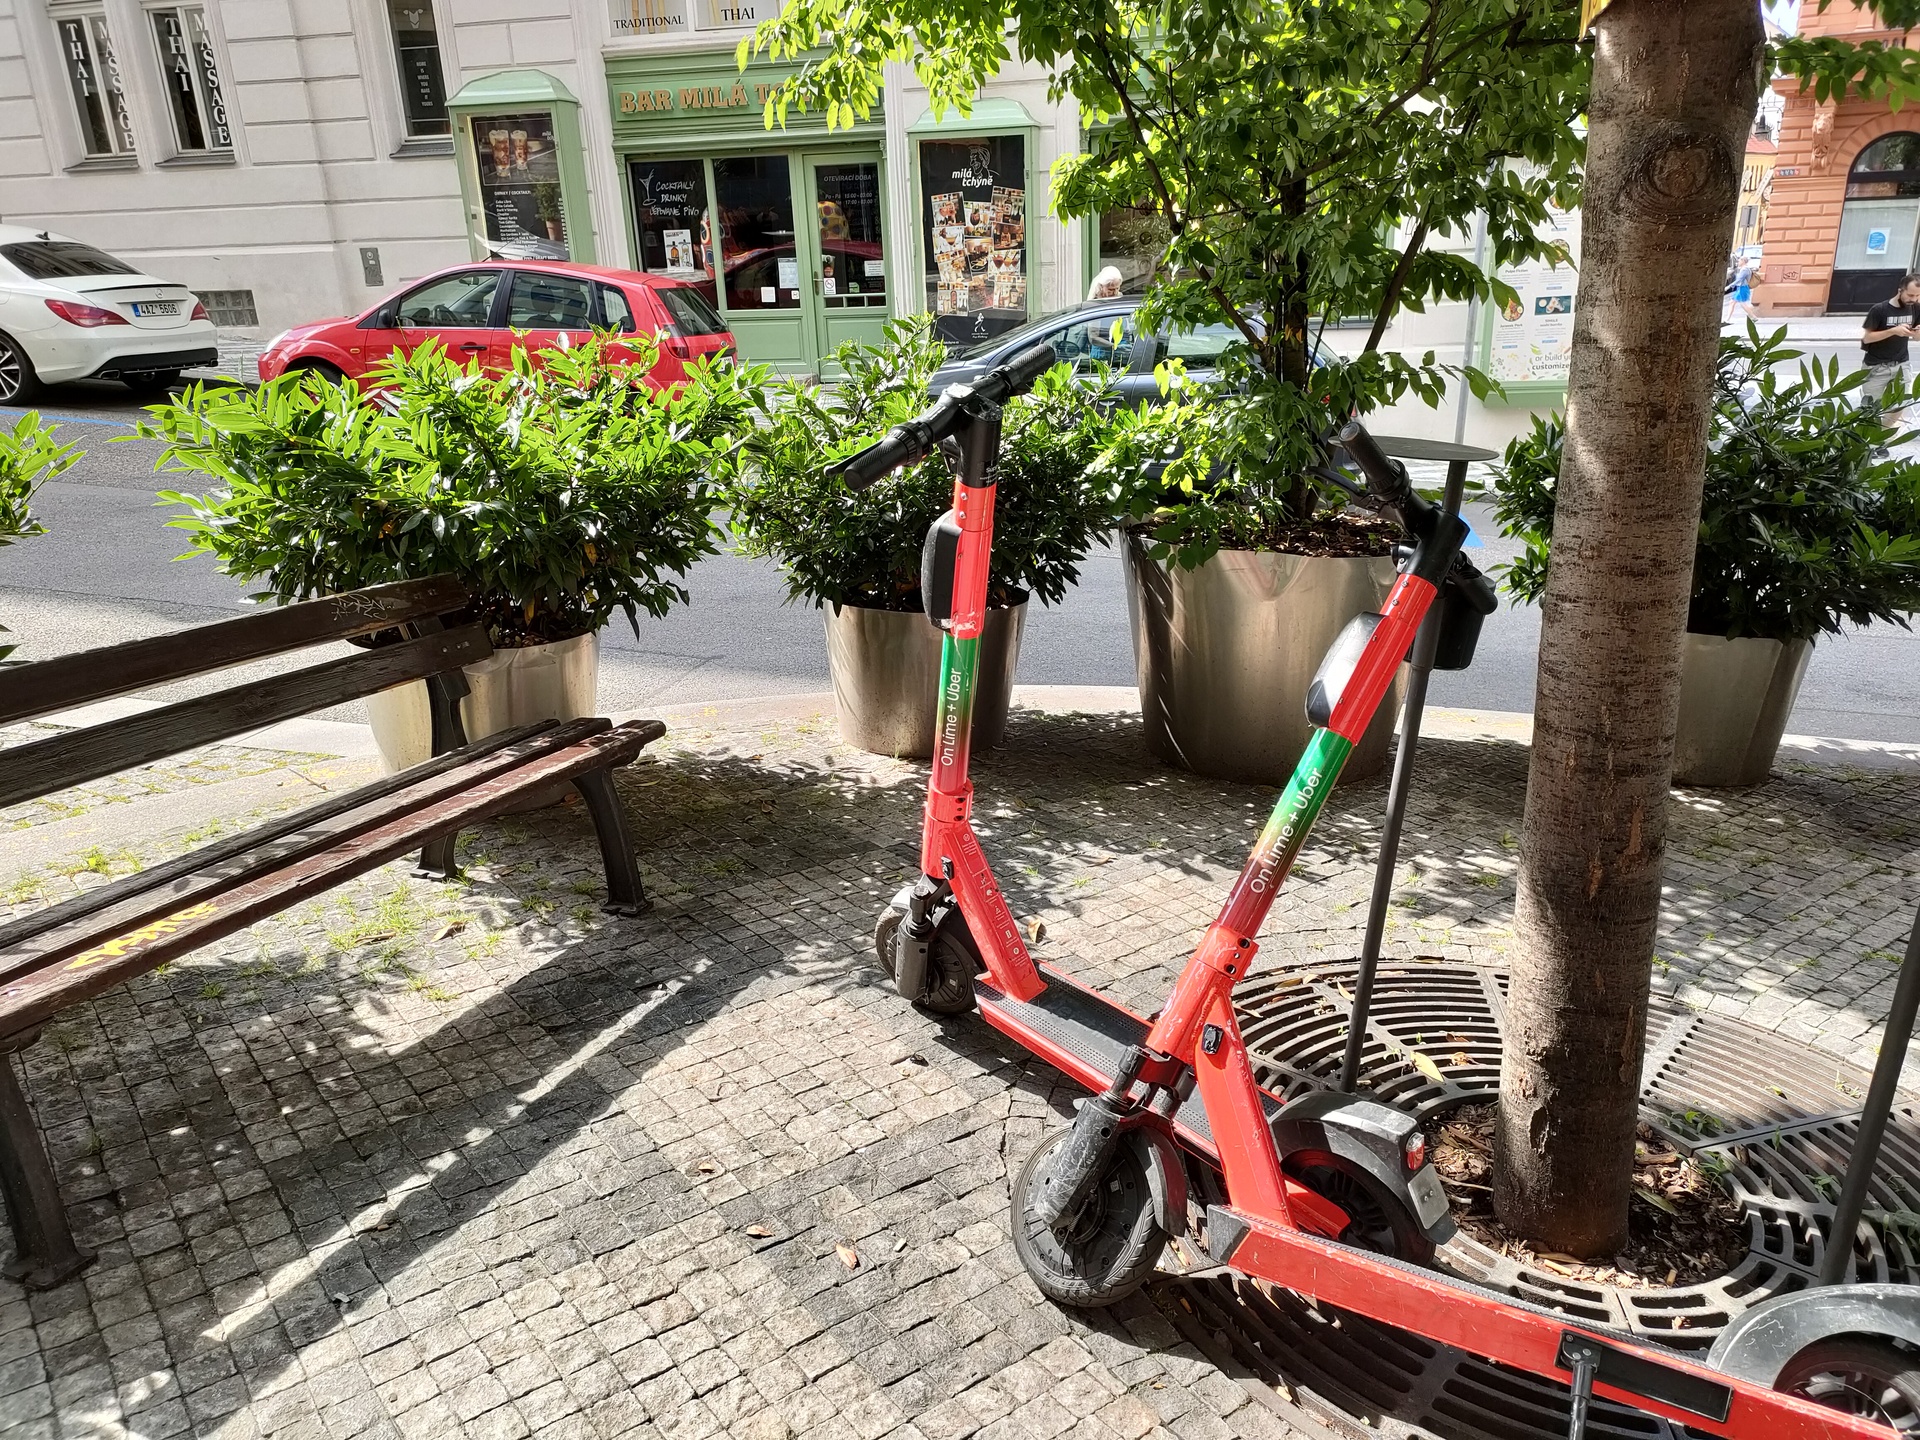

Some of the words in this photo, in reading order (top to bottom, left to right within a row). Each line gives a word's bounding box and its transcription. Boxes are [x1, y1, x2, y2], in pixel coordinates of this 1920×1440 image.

[613, 15, 684, 29] TRADITIONAL
[720, 7, 755, 22] THAI
[66, 23, 90, 97] THAI
[165, 17, 190, 92] THAI
[193, 13, 231, 144] MASSAGE
[619, 88, 674, 113] BAR
[677, 78, 749, 109] MILÁ
[951, 167, 972, 179] milá
[655, 180, 695, 192] COCKTAILY
[660, 193, 688, 203] DRINKY
[140, 303, 156, 315] 4AZ
[946, 667, 962, 701] Uber
[946, 703, 957, 712] +
[942, 714, 958, 746] Lime
[940, 748, 954, 766] On
[1292, 767, 1323, 810] Uber
[1288, 811, 1299, 823] +
[1263, 825, 1294, 867] Lime
[1250, 869, 1273, 894] On
